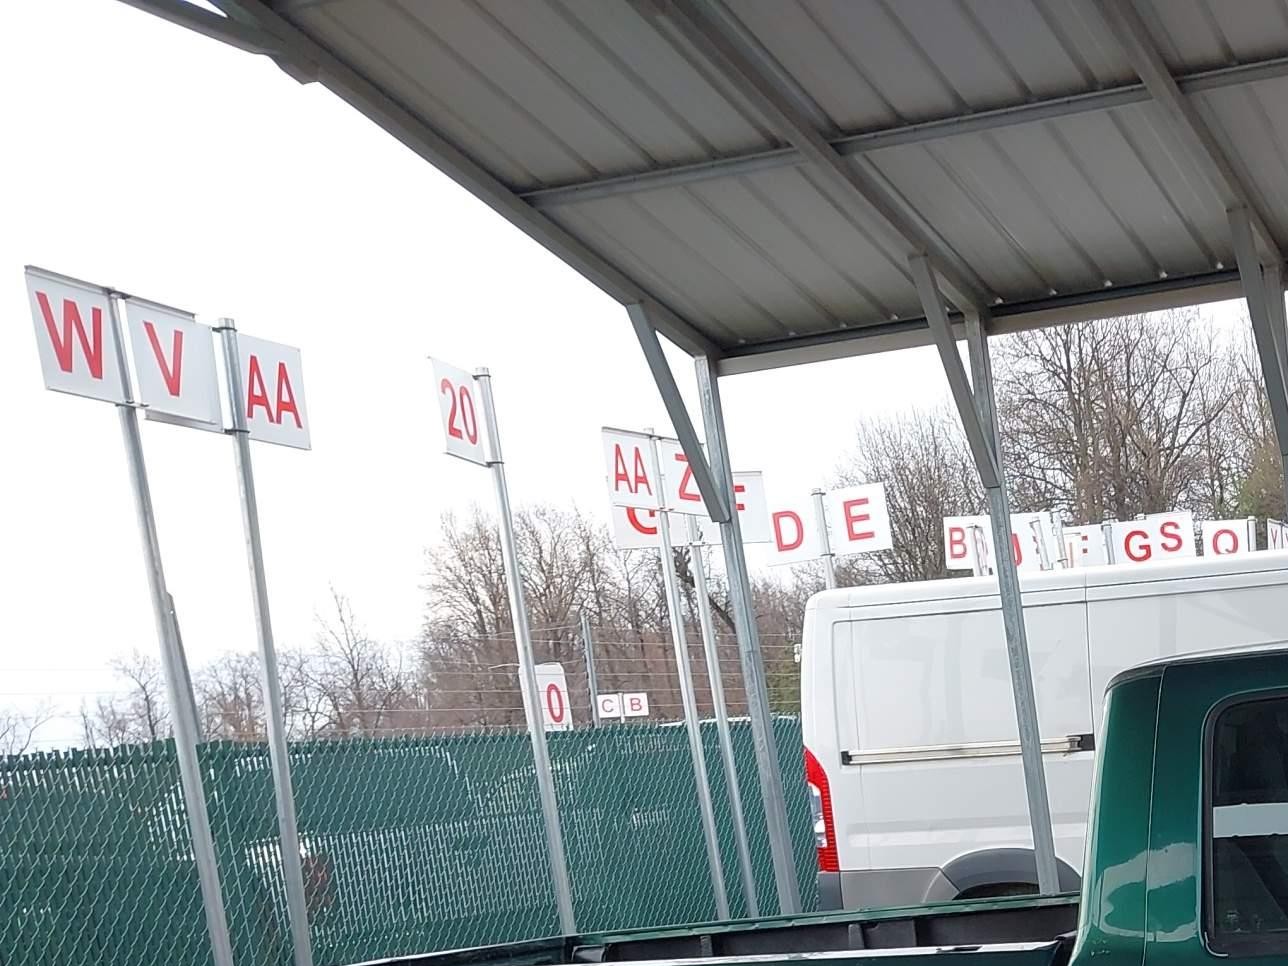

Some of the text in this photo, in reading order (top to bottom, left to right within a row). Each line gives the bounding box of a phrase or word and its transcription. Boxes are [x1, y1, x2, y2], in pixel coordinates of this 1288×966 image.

[36, 291, 104, 380] W
[143, 321, 184, 398] V
[247, 355, 303, 429] AA
[440, 377, 479, 445] 20
[614, 443, 652, 496] AA
[772, 510, 805, 553] D
[842, 497, 876, 543] E
[1160, 521, 1183, 552] S
[948, 526, 968, 560] B
[1124, 530, 1152, 562] G
[601, 699, 615, 713] C
[629, 697, 643, 712] B
